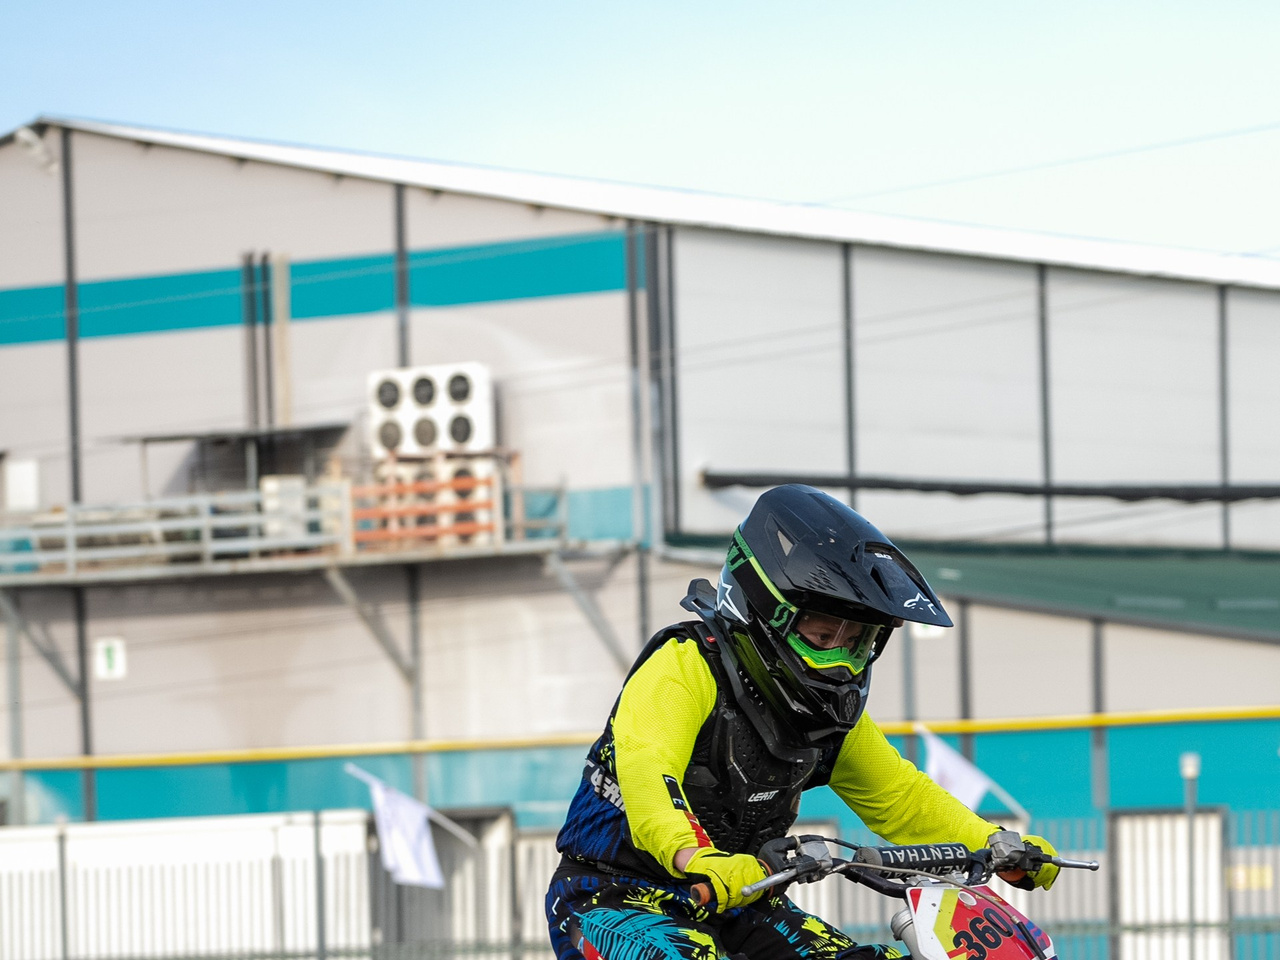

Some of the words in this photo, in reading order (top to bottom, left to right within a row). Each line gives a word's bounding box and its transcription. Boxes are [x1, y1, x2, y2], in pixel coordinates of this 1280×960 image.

[739, 670, 764, 706] LEATT
[748, 790, 779, 802] LEATT
[882, 846, 967, 863] RENTHAL
